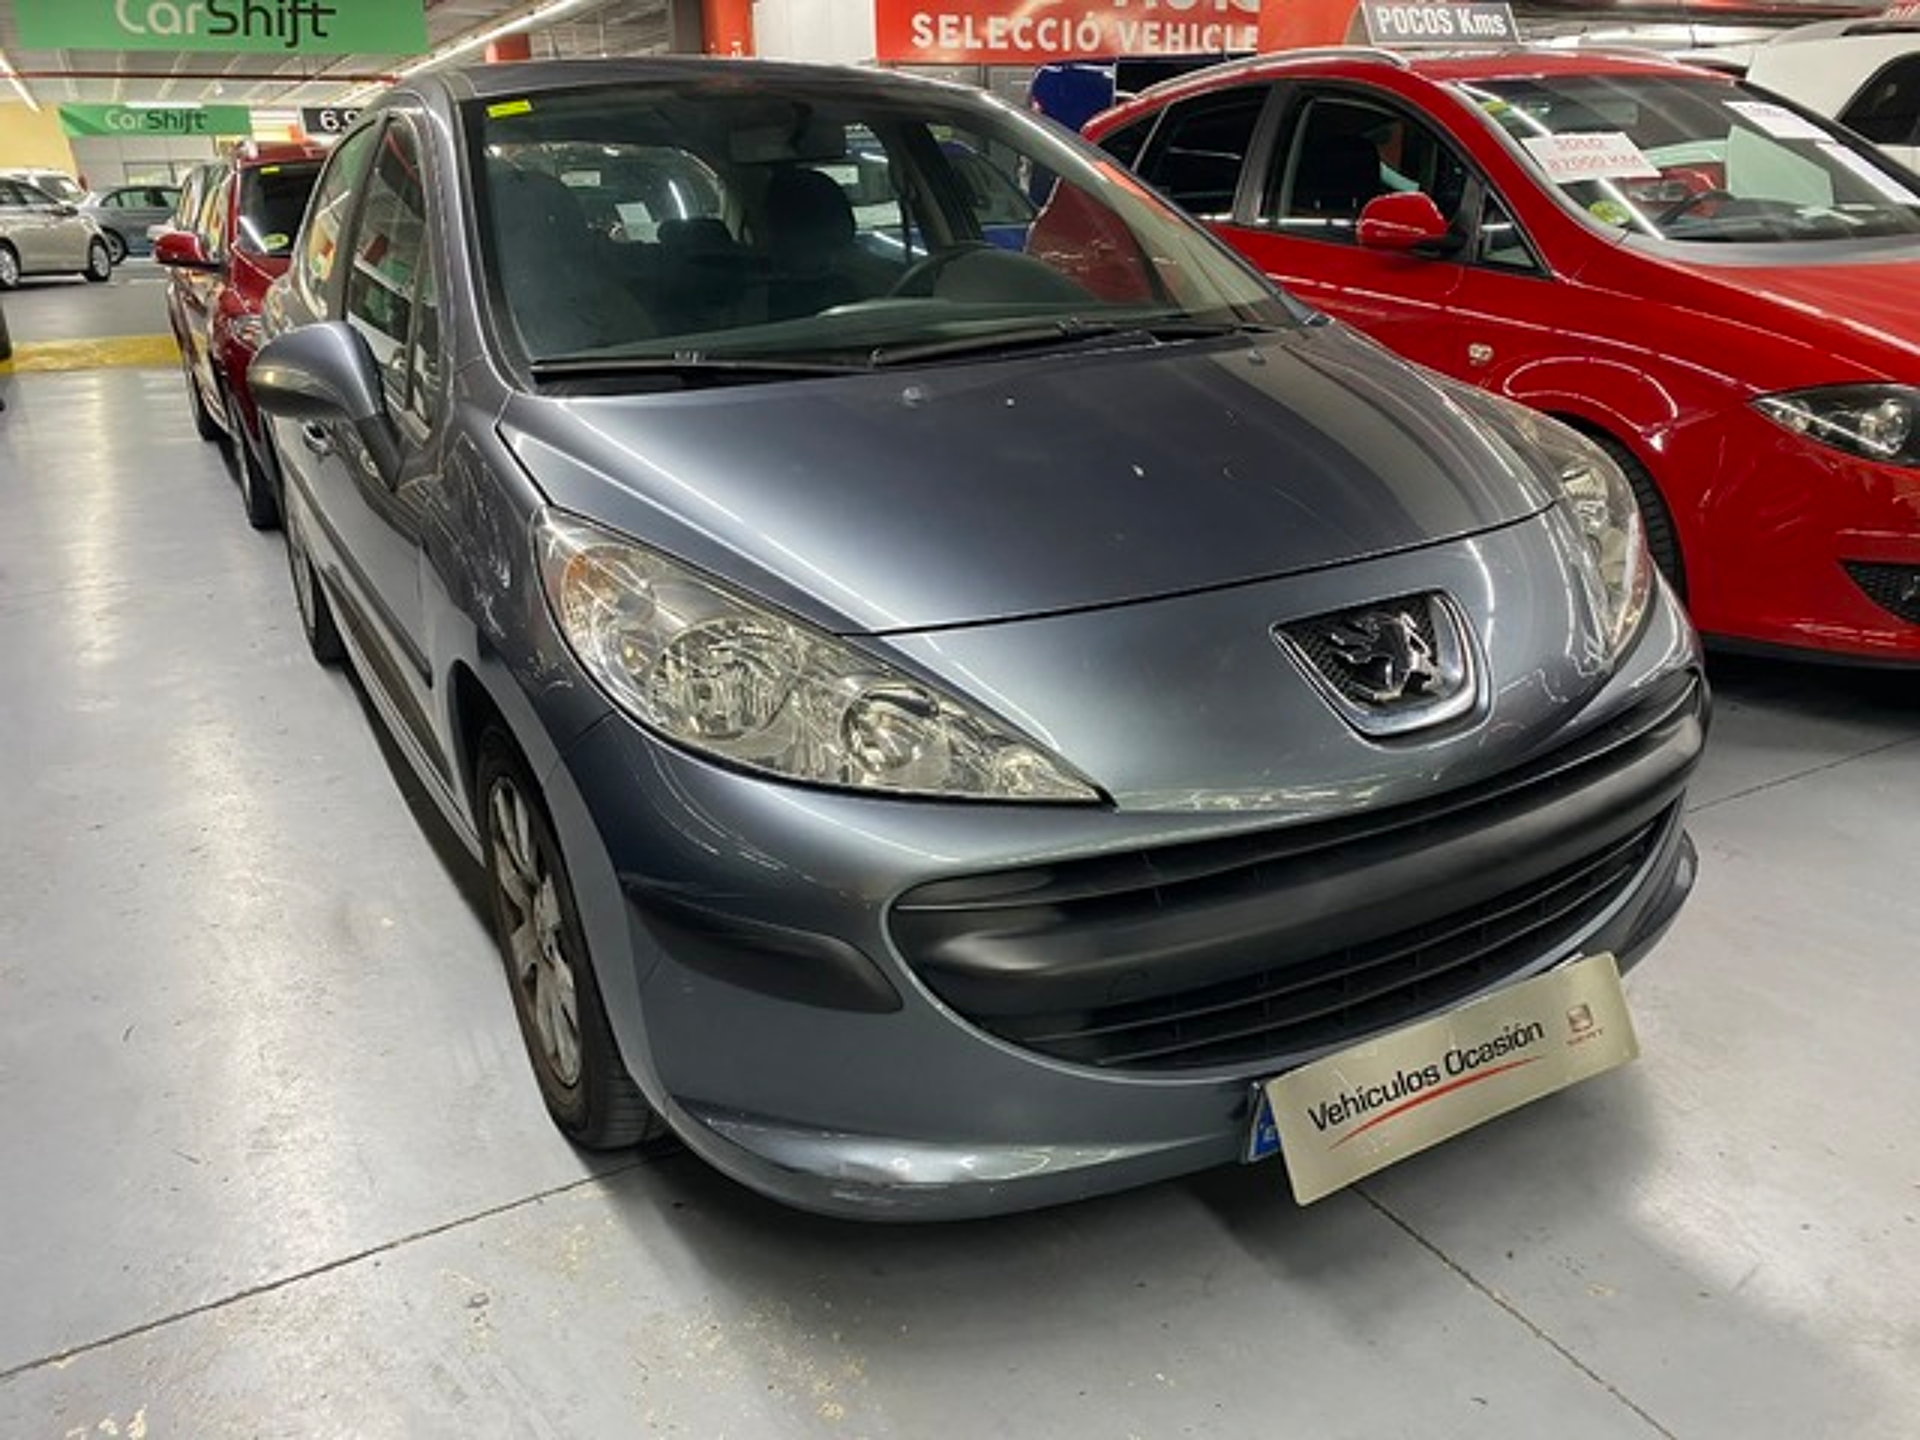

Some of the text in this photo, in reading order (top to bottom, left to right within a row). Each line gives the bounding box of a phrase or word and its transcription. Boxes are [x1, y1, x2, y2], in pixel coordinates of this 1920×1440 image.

[114, 0, 337, 48] CarShift
[911, 11, 1100, 52] SELECCIÓ
[1376, 7, 1507, 36] POCOS Kms
[104, 108, 208, 134] CarShift
[1307, 1021, 1545, 1132] Vehículos Ocasión
